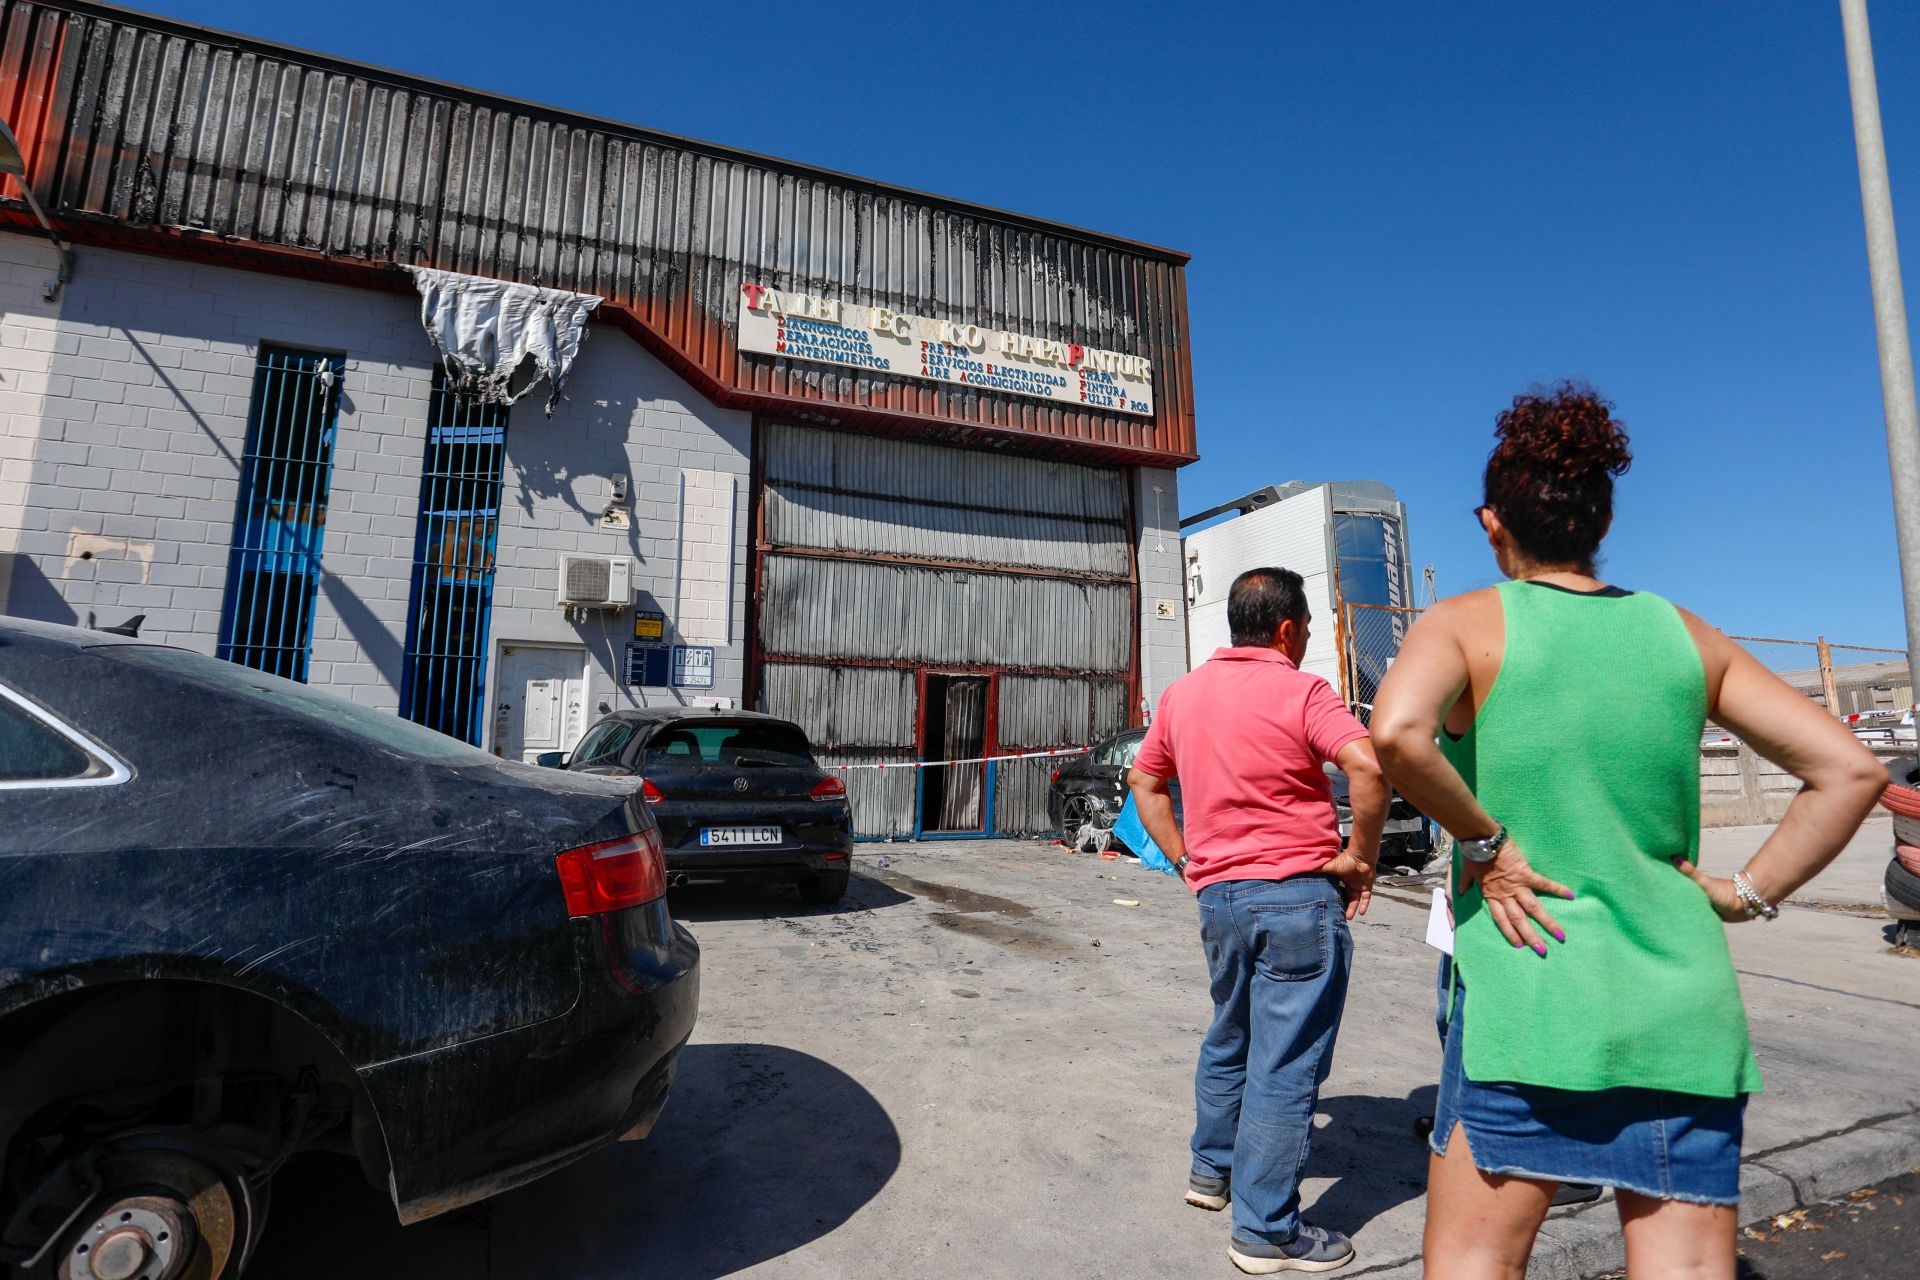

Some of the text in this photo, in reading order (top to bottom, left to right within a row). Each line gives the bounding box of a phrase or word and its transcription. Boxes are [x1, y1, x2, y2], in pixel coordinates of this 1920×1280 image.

[777, 315, 869, 342] DIAGNOSTICOS
[777, 328, 873, 355] REPARACIONES
[776, 341, 890, 370] MANTENIMIENTOS
[921, 353, 1067, 388] SERVICIOS ELECTRICIDAD
[921, 365, 1053, 396] AIRE ACONDICIONADO
[1079, 380, 1127, 399] PINTURA
[1079, 392, 1115, 407] PULIR
[711, 827, 779, 843] 5411 LCN
